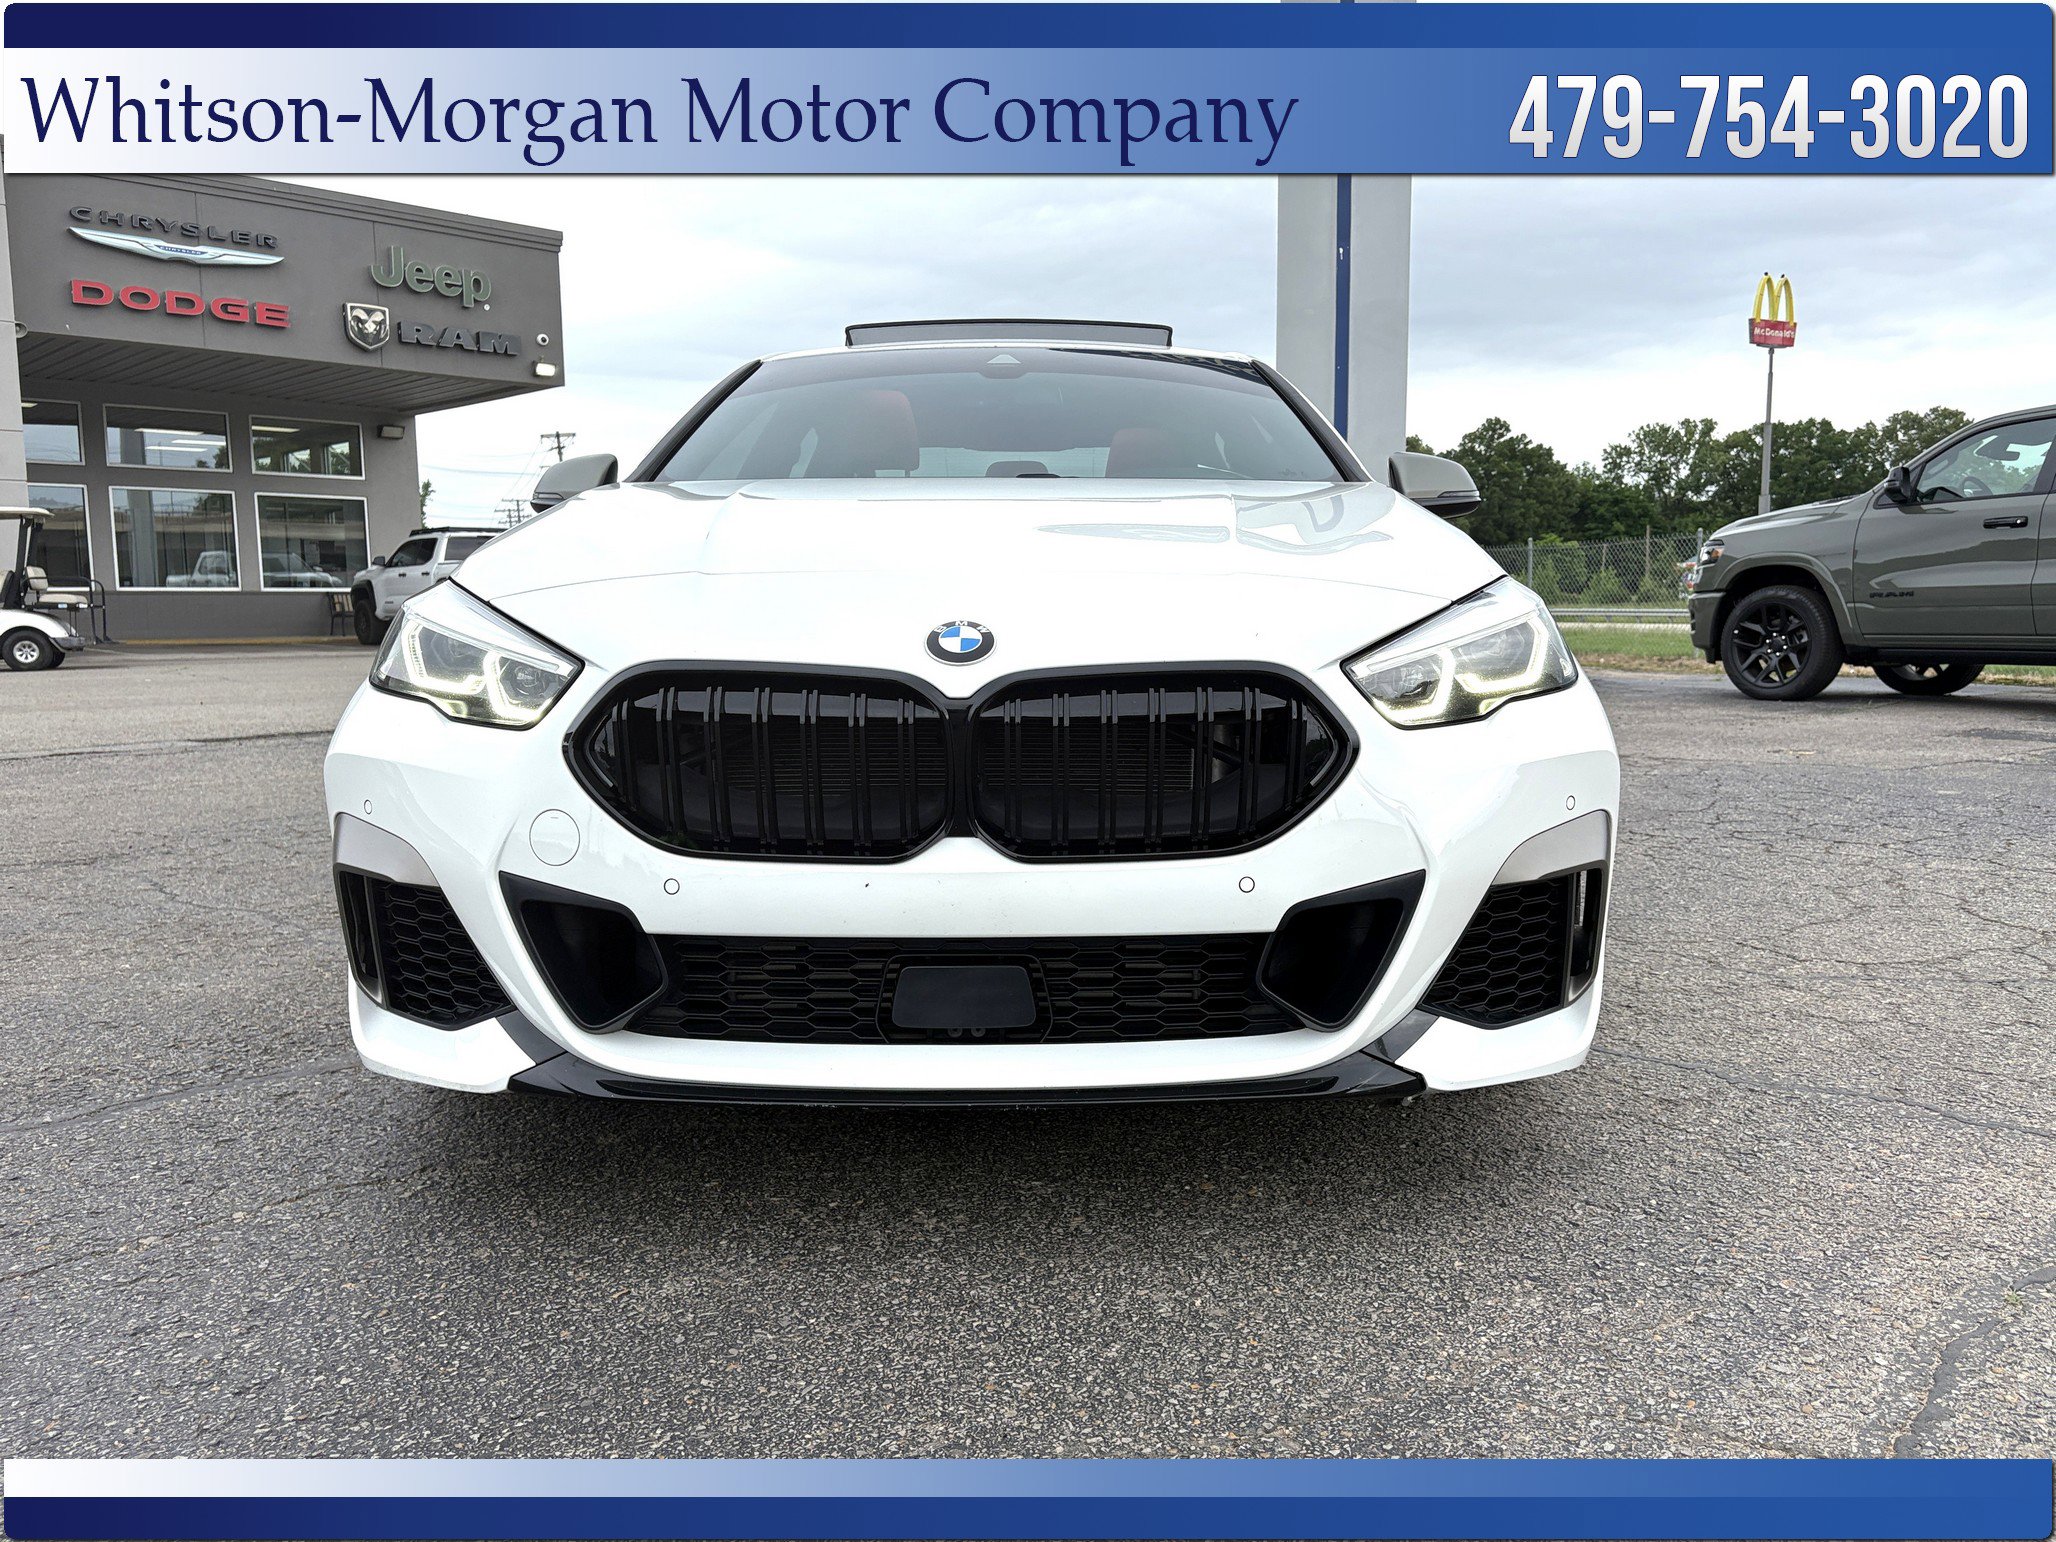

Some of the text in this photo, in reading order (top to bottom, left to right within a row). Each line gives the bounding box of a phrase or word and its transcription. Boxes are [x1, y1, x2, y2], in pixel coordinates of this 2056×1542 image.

[69, 206, 279, 248] CHRYSLER
[370, 246, 491, 308] Jeep
[71, 279, 290, 328] DODGE
[398, 320, 521, 355] RAM
[1754, 327, 1794, 338] McDonald's
[934, 620, 990, 633] BMW
